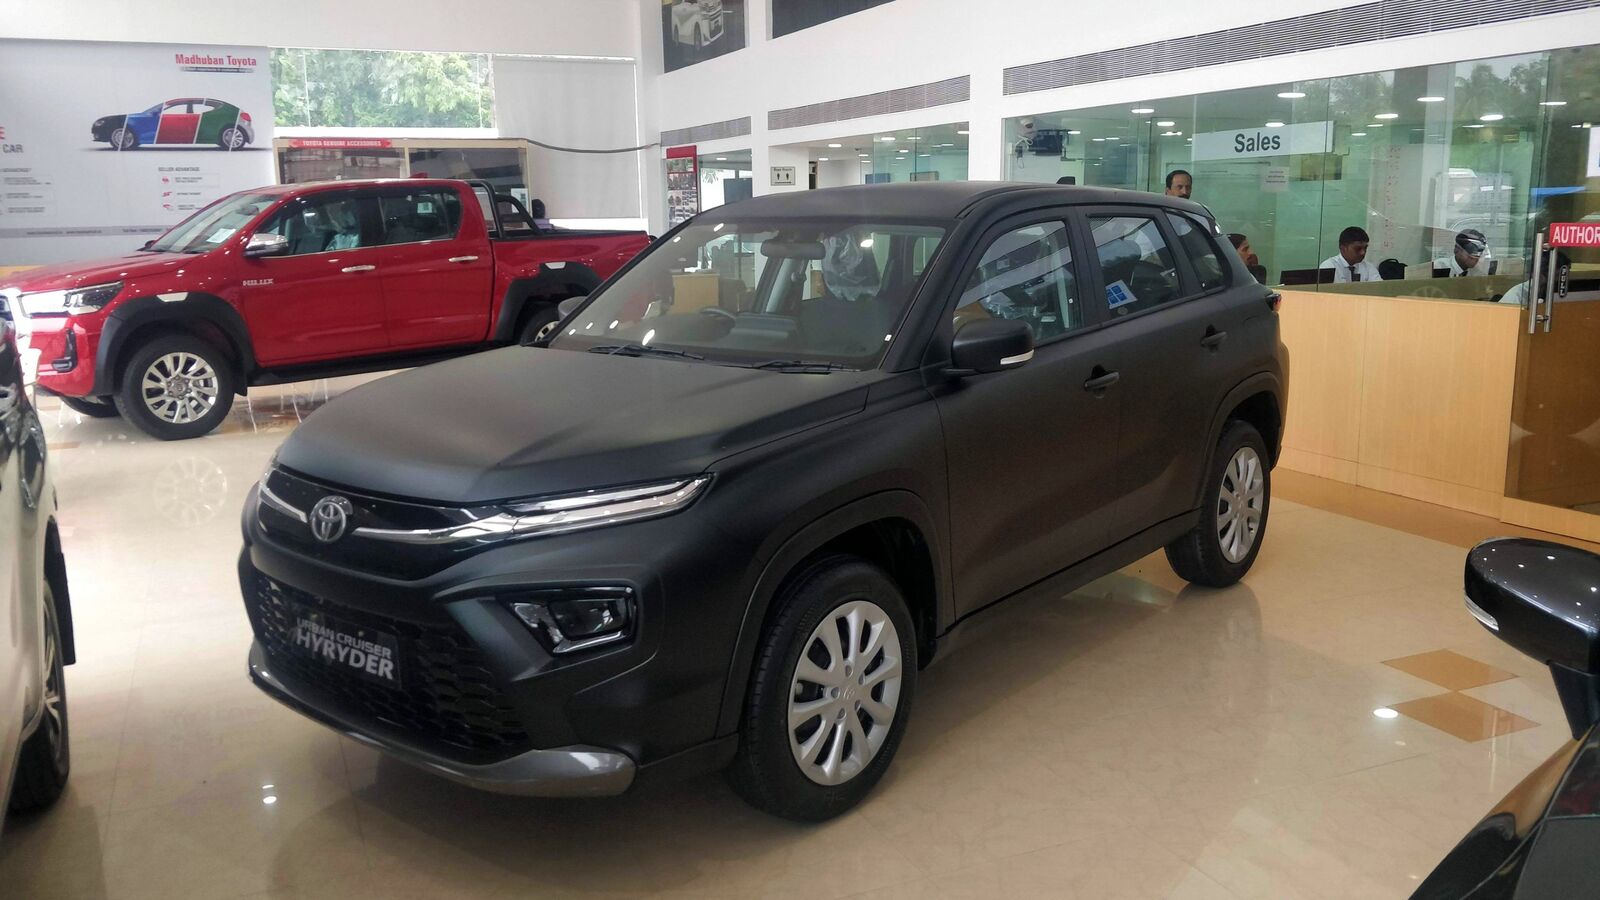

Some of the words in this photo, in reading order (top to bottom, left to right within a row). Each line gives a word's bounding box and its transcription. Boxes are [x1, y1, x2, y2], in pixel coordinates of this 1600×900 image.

[175, 54, 224, 65] Madhuban
[226, 55, 257, 67] Toyota
[2, 144, 24, 153] CAR
[1234, 132, 1281, 153] Sales
[242, 278, 274, 287] HILUX
[297, 617, 335, 641] URBAN
[336, 632, 391, 660] CRUISER
[296, 627, 394, 680] HYRYDER
